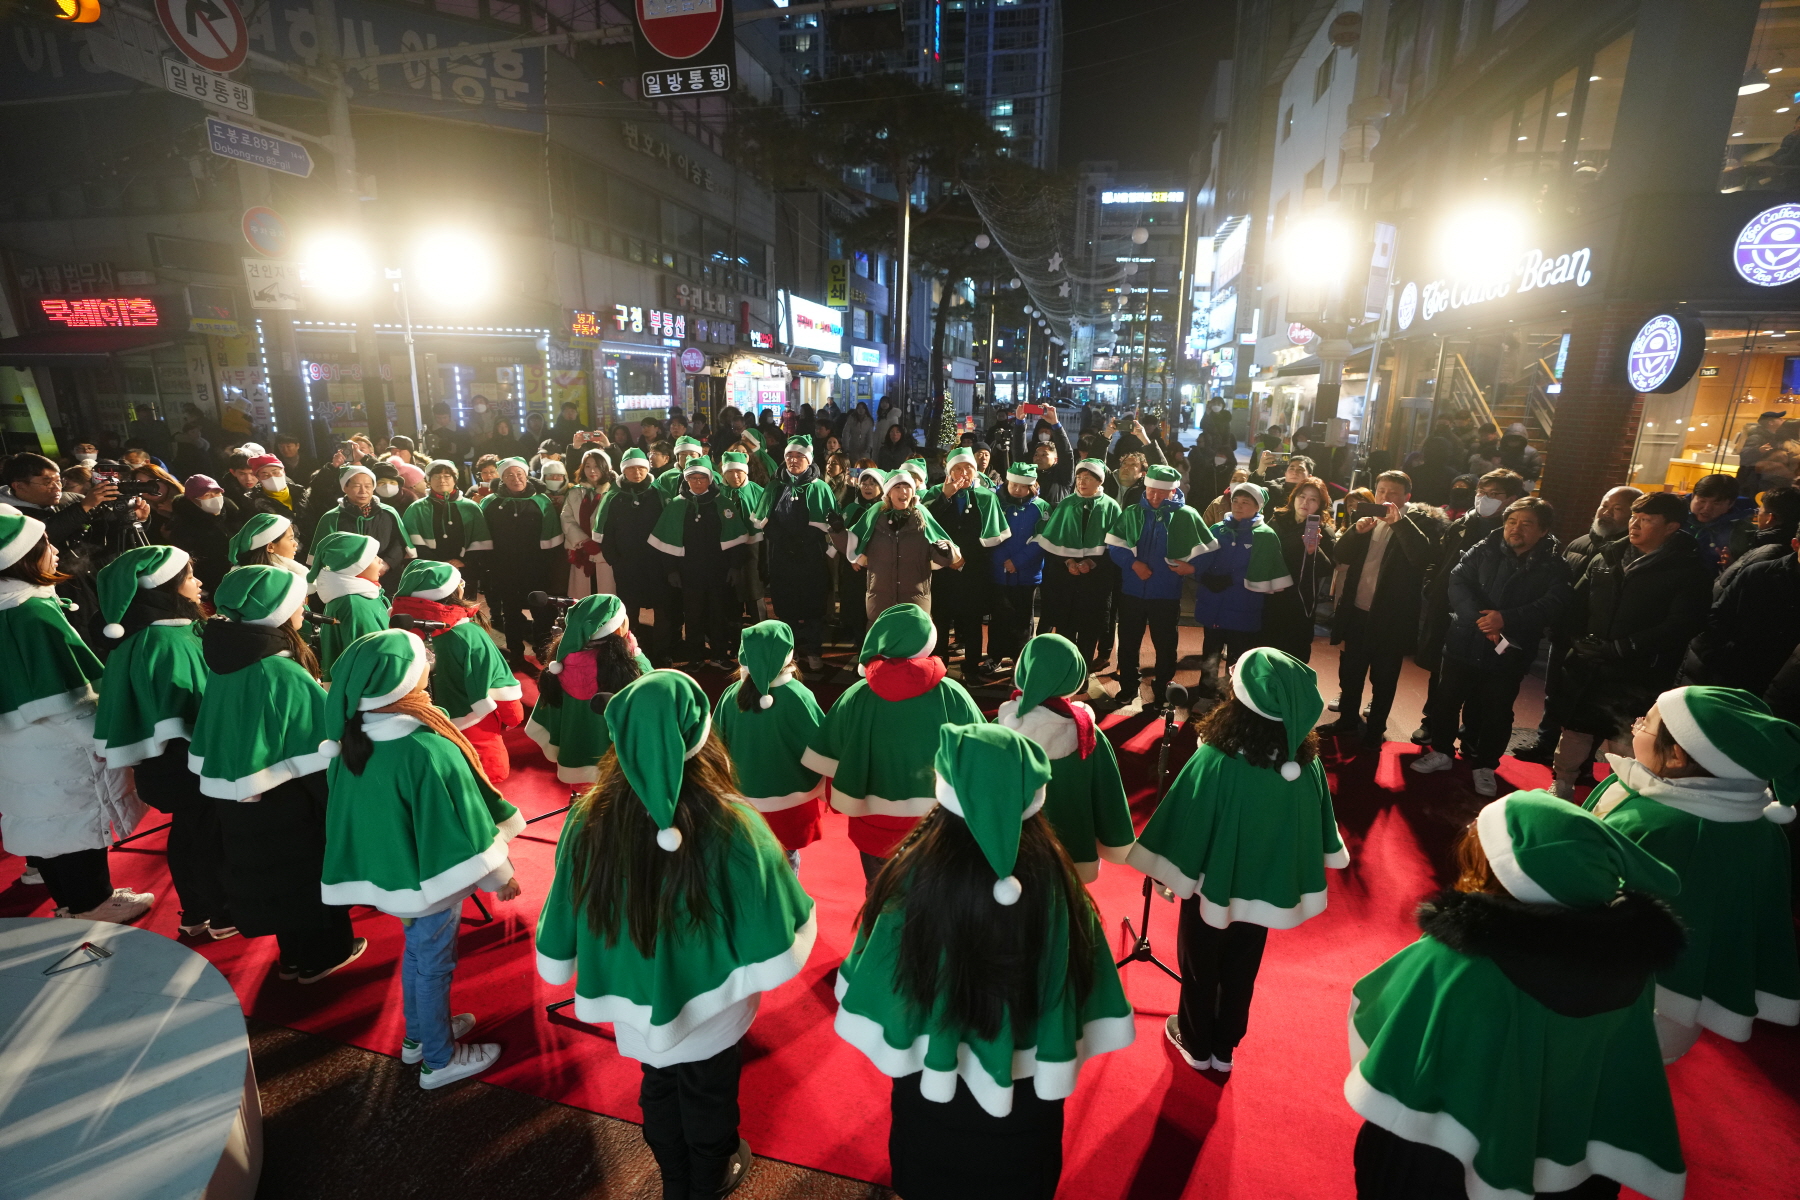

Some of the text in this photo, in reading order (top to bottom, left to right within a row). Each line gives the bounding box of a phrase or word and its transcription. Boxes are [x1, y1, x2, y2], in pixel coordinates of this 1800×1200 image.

[170, 65, 249, 110] 일방통행
[646, 68, 726, 94] 일방통행
[213, 124, 280, 156] 도봉로89길
[214, 141, 291, 170] Dobong-ro 89-gil
[831, 264, 846, 301] 인쇄
[1422, 280, 1451, 321] The
[1514, 247, 1592, 294] Bean
[1773, 266, 1800, 282] Lea
[572, 324, 600, 336] 부동산
[612, 304, 643, 333] 구청
[650, 309, 686, 338] 부동산
[309, 362, 393, 381] 991-30
[683, 359, 702, 368] 부동산
[761, 391, 782, 403] 인쇄
